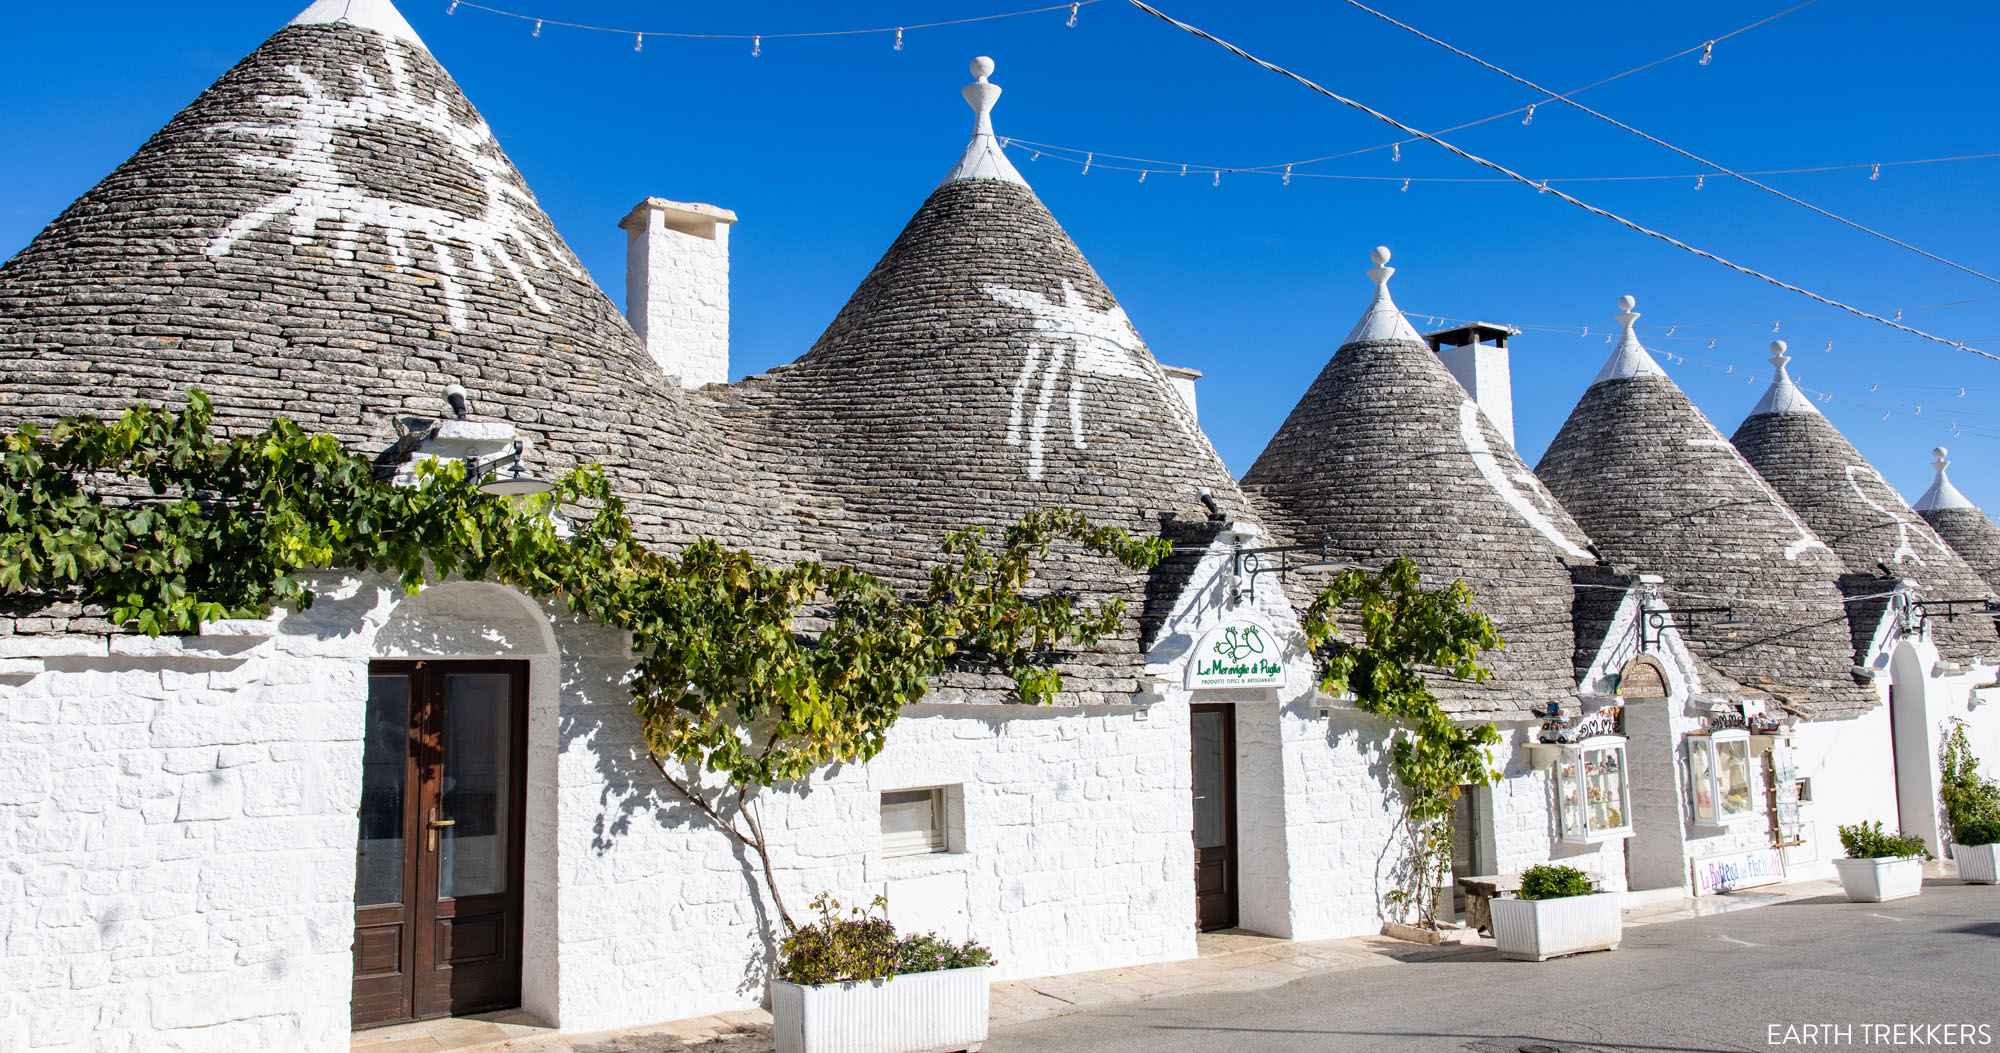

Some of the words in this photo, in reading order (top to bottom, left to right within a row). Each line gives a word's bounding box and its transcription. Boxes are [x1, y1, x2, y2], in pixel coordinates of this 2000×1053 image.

[1197, 659, 1211, 675] Le
[1212, 659, 1249, 678] Meraviglie
[1251, 663, 1258, 674] di
[1260, 658, 1281, 677] Puglia
[1700, 870, 1710, 890] La
[1709, 861, 1739, 888] Bottega
